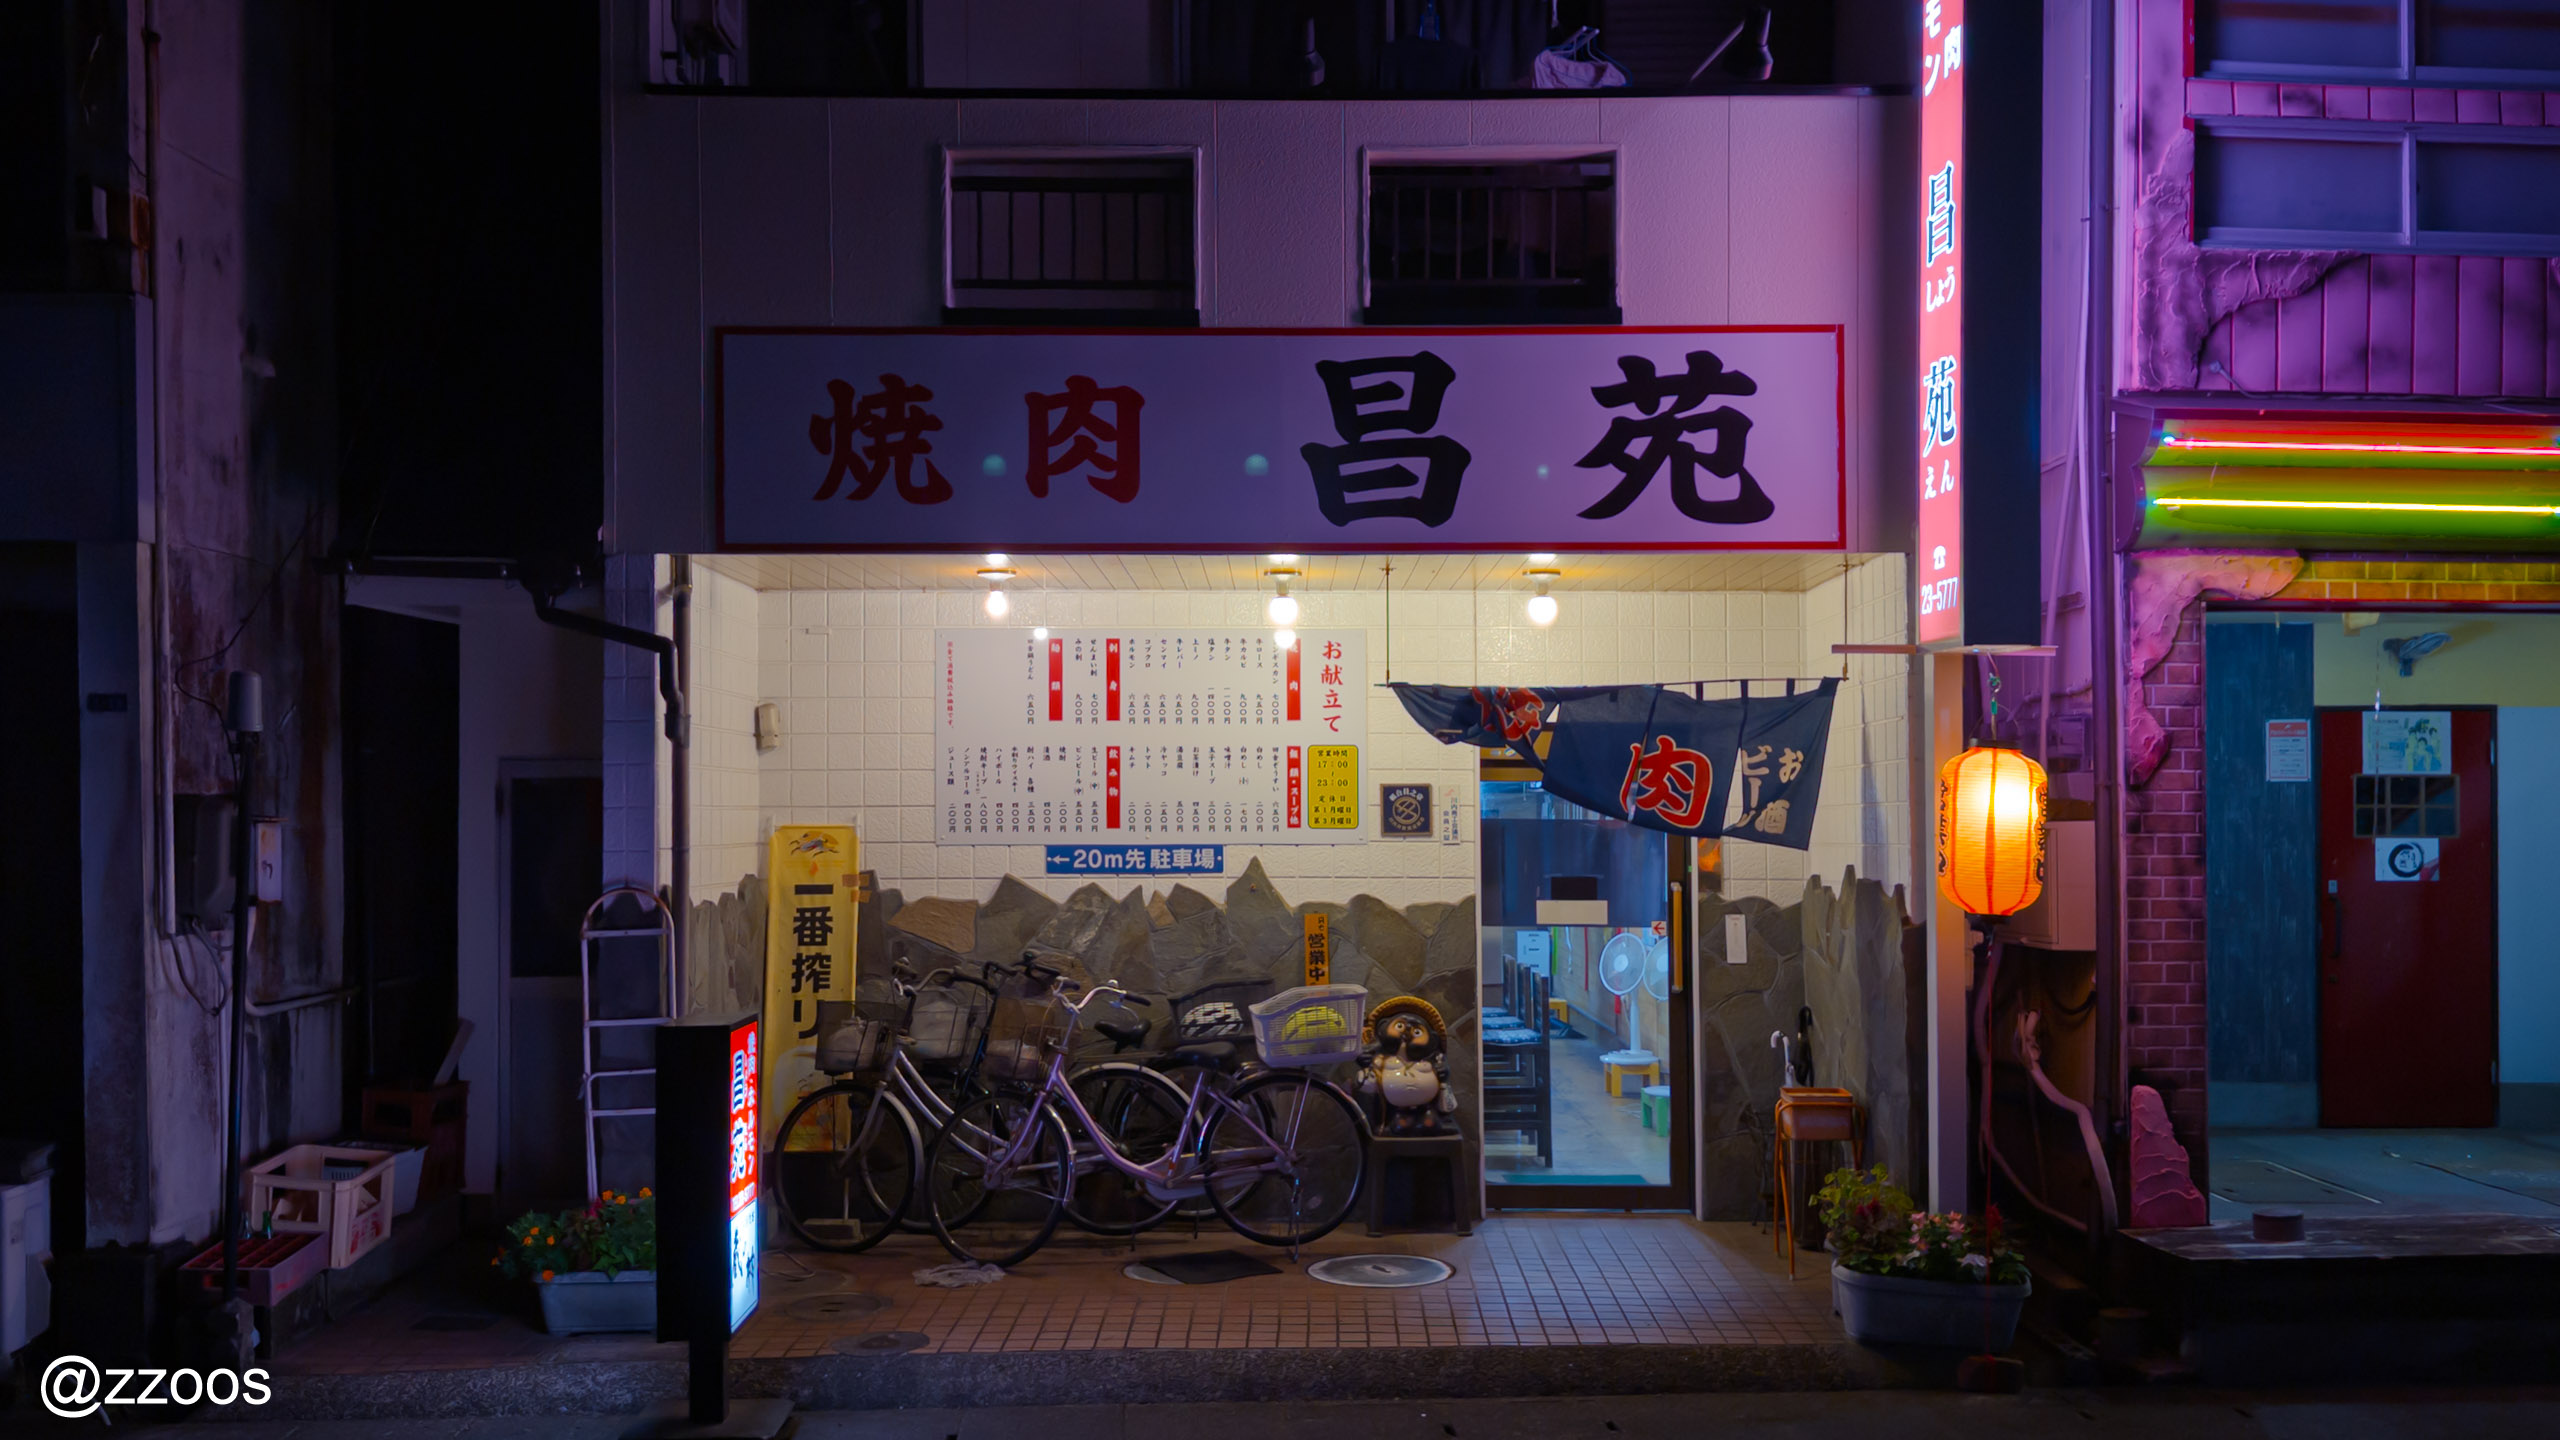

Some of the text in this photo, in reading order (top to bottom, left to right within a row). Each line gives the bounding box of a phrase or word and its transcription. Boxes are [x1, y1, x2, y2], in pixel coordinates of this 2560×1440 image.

[1926, 266, 1956, 313] しょう
[809, 350, 1777, 528] 焼肉 昌苑
[1924, 459, 1955, 500] えん
[1921, 576, 1959, 615] 23-5777
[1027, 694, 1035, 724] 六五〇円
[1075, 638, 1083, 724] みの刺 九〇〇円
[1090, 639, 1098, 724] せんまい刺 七〇〇円
[1128, 639, 1136, 724] ホルモン 六五〇円
[1143, 639, 1152, 724] コブクロ 六五〇円
[1159, 639, 1168, 724] センマイ 六五〇円
[1175, 638, 1184, 724] 牛レバー 六五〇円
[1191, 639, 1200, 724] 上ミノ 九〇〇円
[1207, 688, 1215, 724] 一四〇〇円
[1223, 638, 1231, 724] 牛タン 一一〇〇円
[1239, 638, 1248, 724] 牛カルビ 九〇〇円
[1256, 638, 1264, 724] 牛ロース 九五〇円
[1272, 646, 1280, 724] ンギスカン 七〇〇円
[1321, 640, 1343, 733] お献立て
[947, 747, 956, 832] ジュース類 二〇〇円
[995, 747, 1003, 832] ハイボール 四〇〇円
[1027, 778, 1035, 793] 各種
[1043, 746, 1051, 832] 清酒 四〇〇円
[1059, 746, 1067, 832] 焼酎 二〇〇円
[1109, 749, 1119, 797] 飲み物
[1128, 747, 1136, 832] キムチ 二〇〇円
[1144, 747, 1152, 832] トマト 二〇〇円
[1160, 747, 1168, 832] 冷ヤッコ 二五〇円
[1192, 747, 1200, 832] お茶漬け 四五〇円
[1208, 747, 1216, 832] 玉子スープ 三〇〇円
[1272, 747, 1280, 832] 田舎ぞうすい 六五〇円
[1619, 734, 1713, 829] 肉
[1755, 747, 1804, 835] お酒
[964, 803, 972, 833] 四〇〇円
[1011, 802, 1019, 832] 四〇〇円
[1027, 802, 1035, 832] 三五〇円
[1075, 801, 1083, 832] 五五〇円
[1091, 801, 1099, 832] 五五〇円
[1176, 801, 1184, 832] 五〇〇円
[1224, 802, 1232, 832] 二〇〇円
[1256, 802, 1264, 832] 二〇〇円
[792, 884, 834, 1040] 一番搾り
[1308, 933, 1325, 981] 営業中
